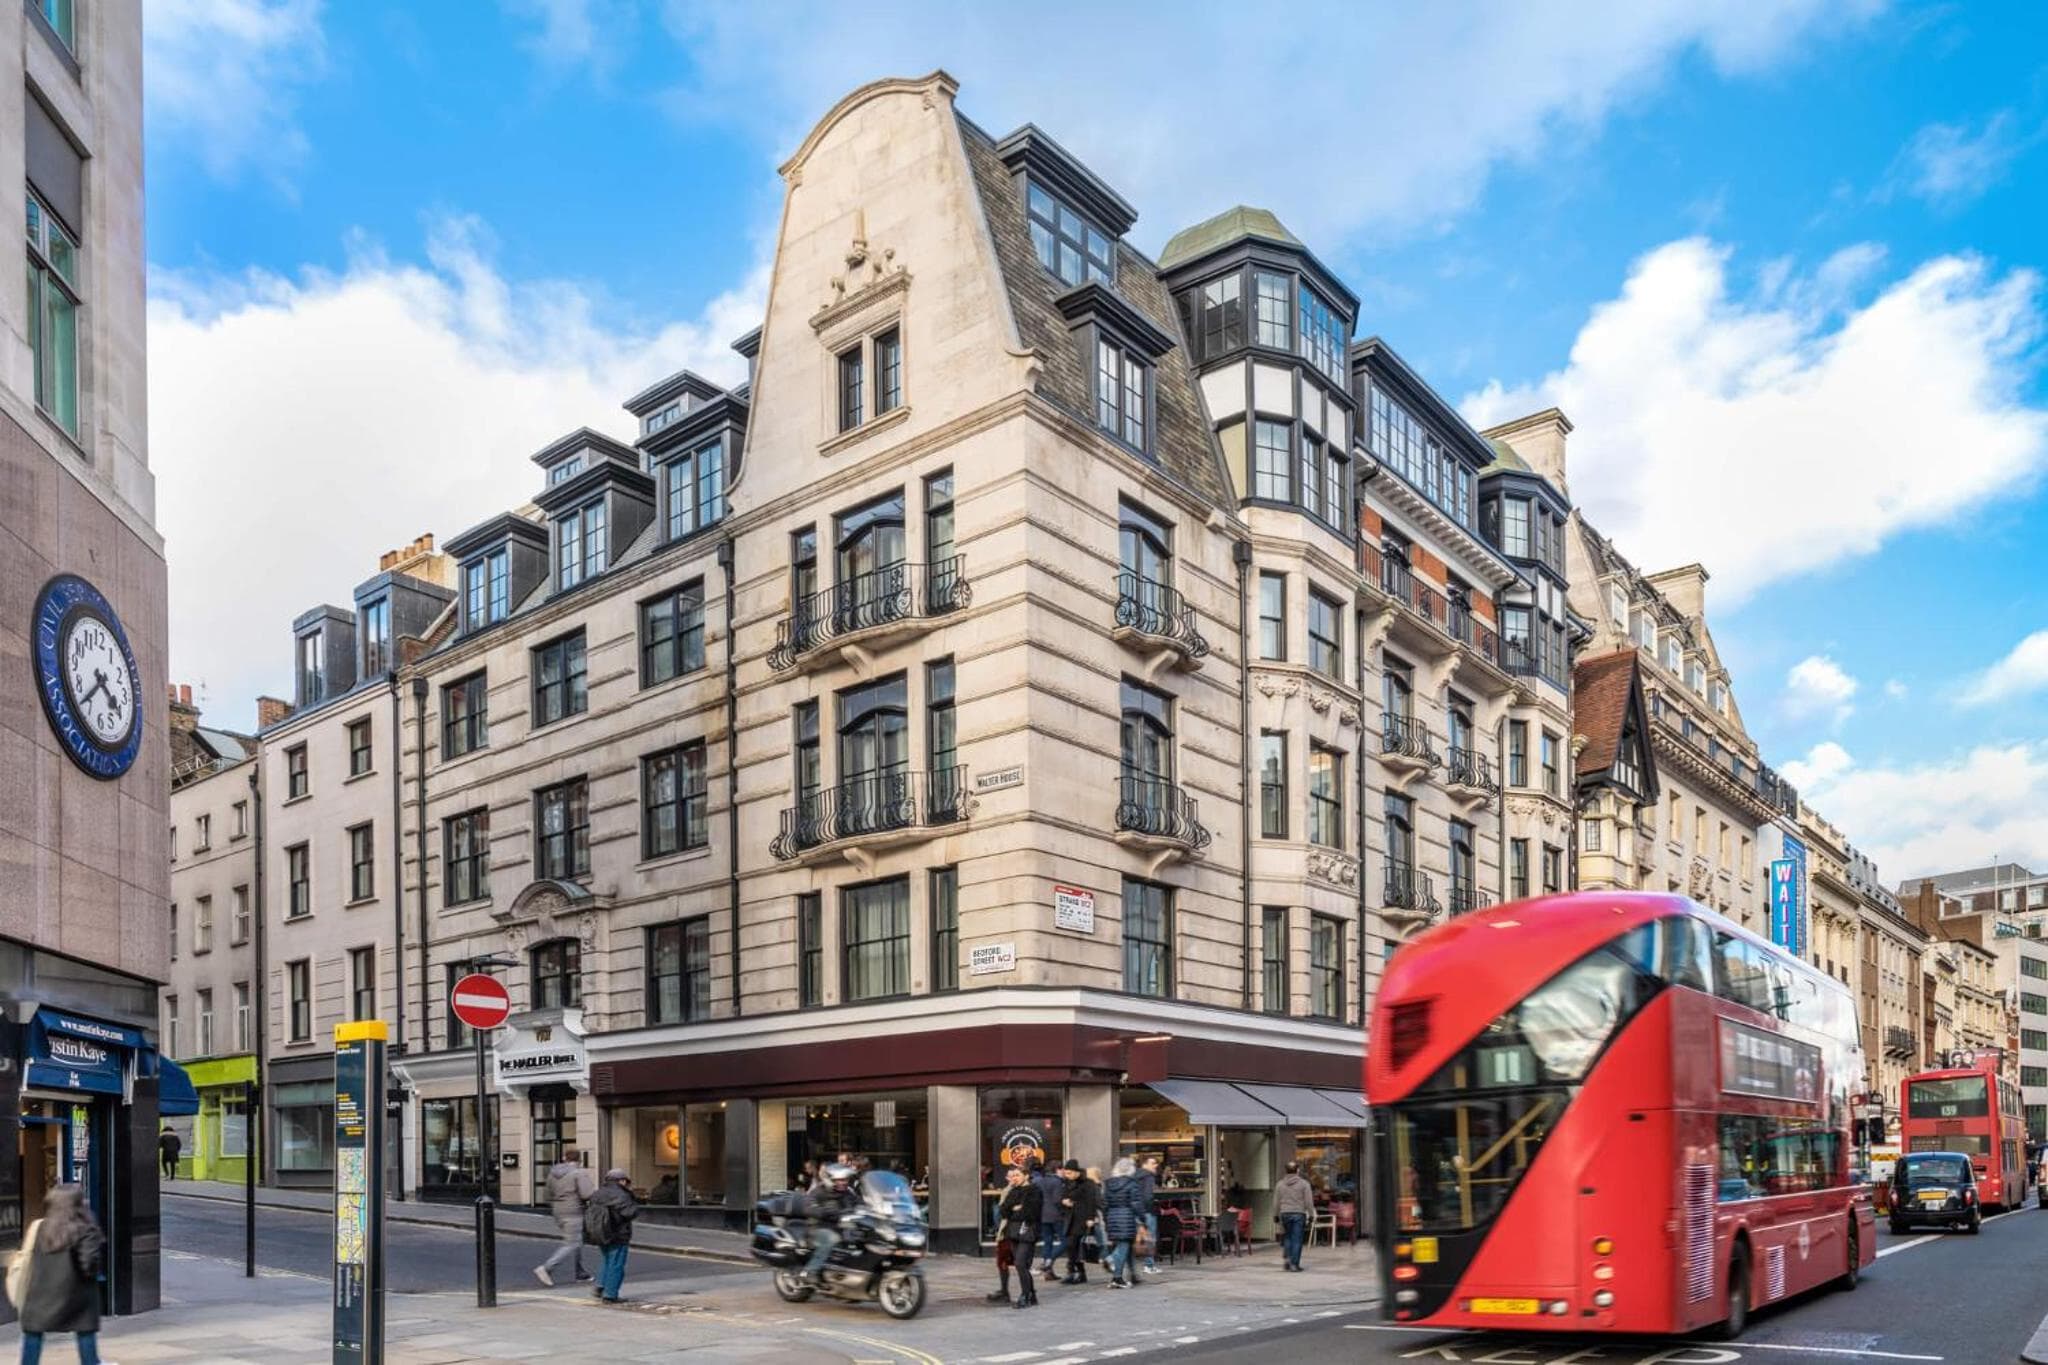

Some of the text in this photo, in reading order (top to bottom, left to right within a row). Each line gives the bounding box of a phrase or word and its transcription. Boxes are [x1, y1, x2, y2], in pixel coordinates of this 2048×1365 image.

[41, 598, 64, 649] CIVIL
[75, 638, 85, 658] 10
[84, 629, 93, 650] 11
[94, 628, 105, 650] 12
[71, 653, 79, 671] 9
[108, 647, 113, 665] 1
[76, 673, 83, 693] 8
[116, 666, 123, 684] 2
[121, 687, 128, 705] 3
[97, 712, 105, 731] 6
[107, 712, 115, 730] 5
[49, 1039, 107, 1065] ustin Kaye
[1941, 1105, 1957, 1116] 139
